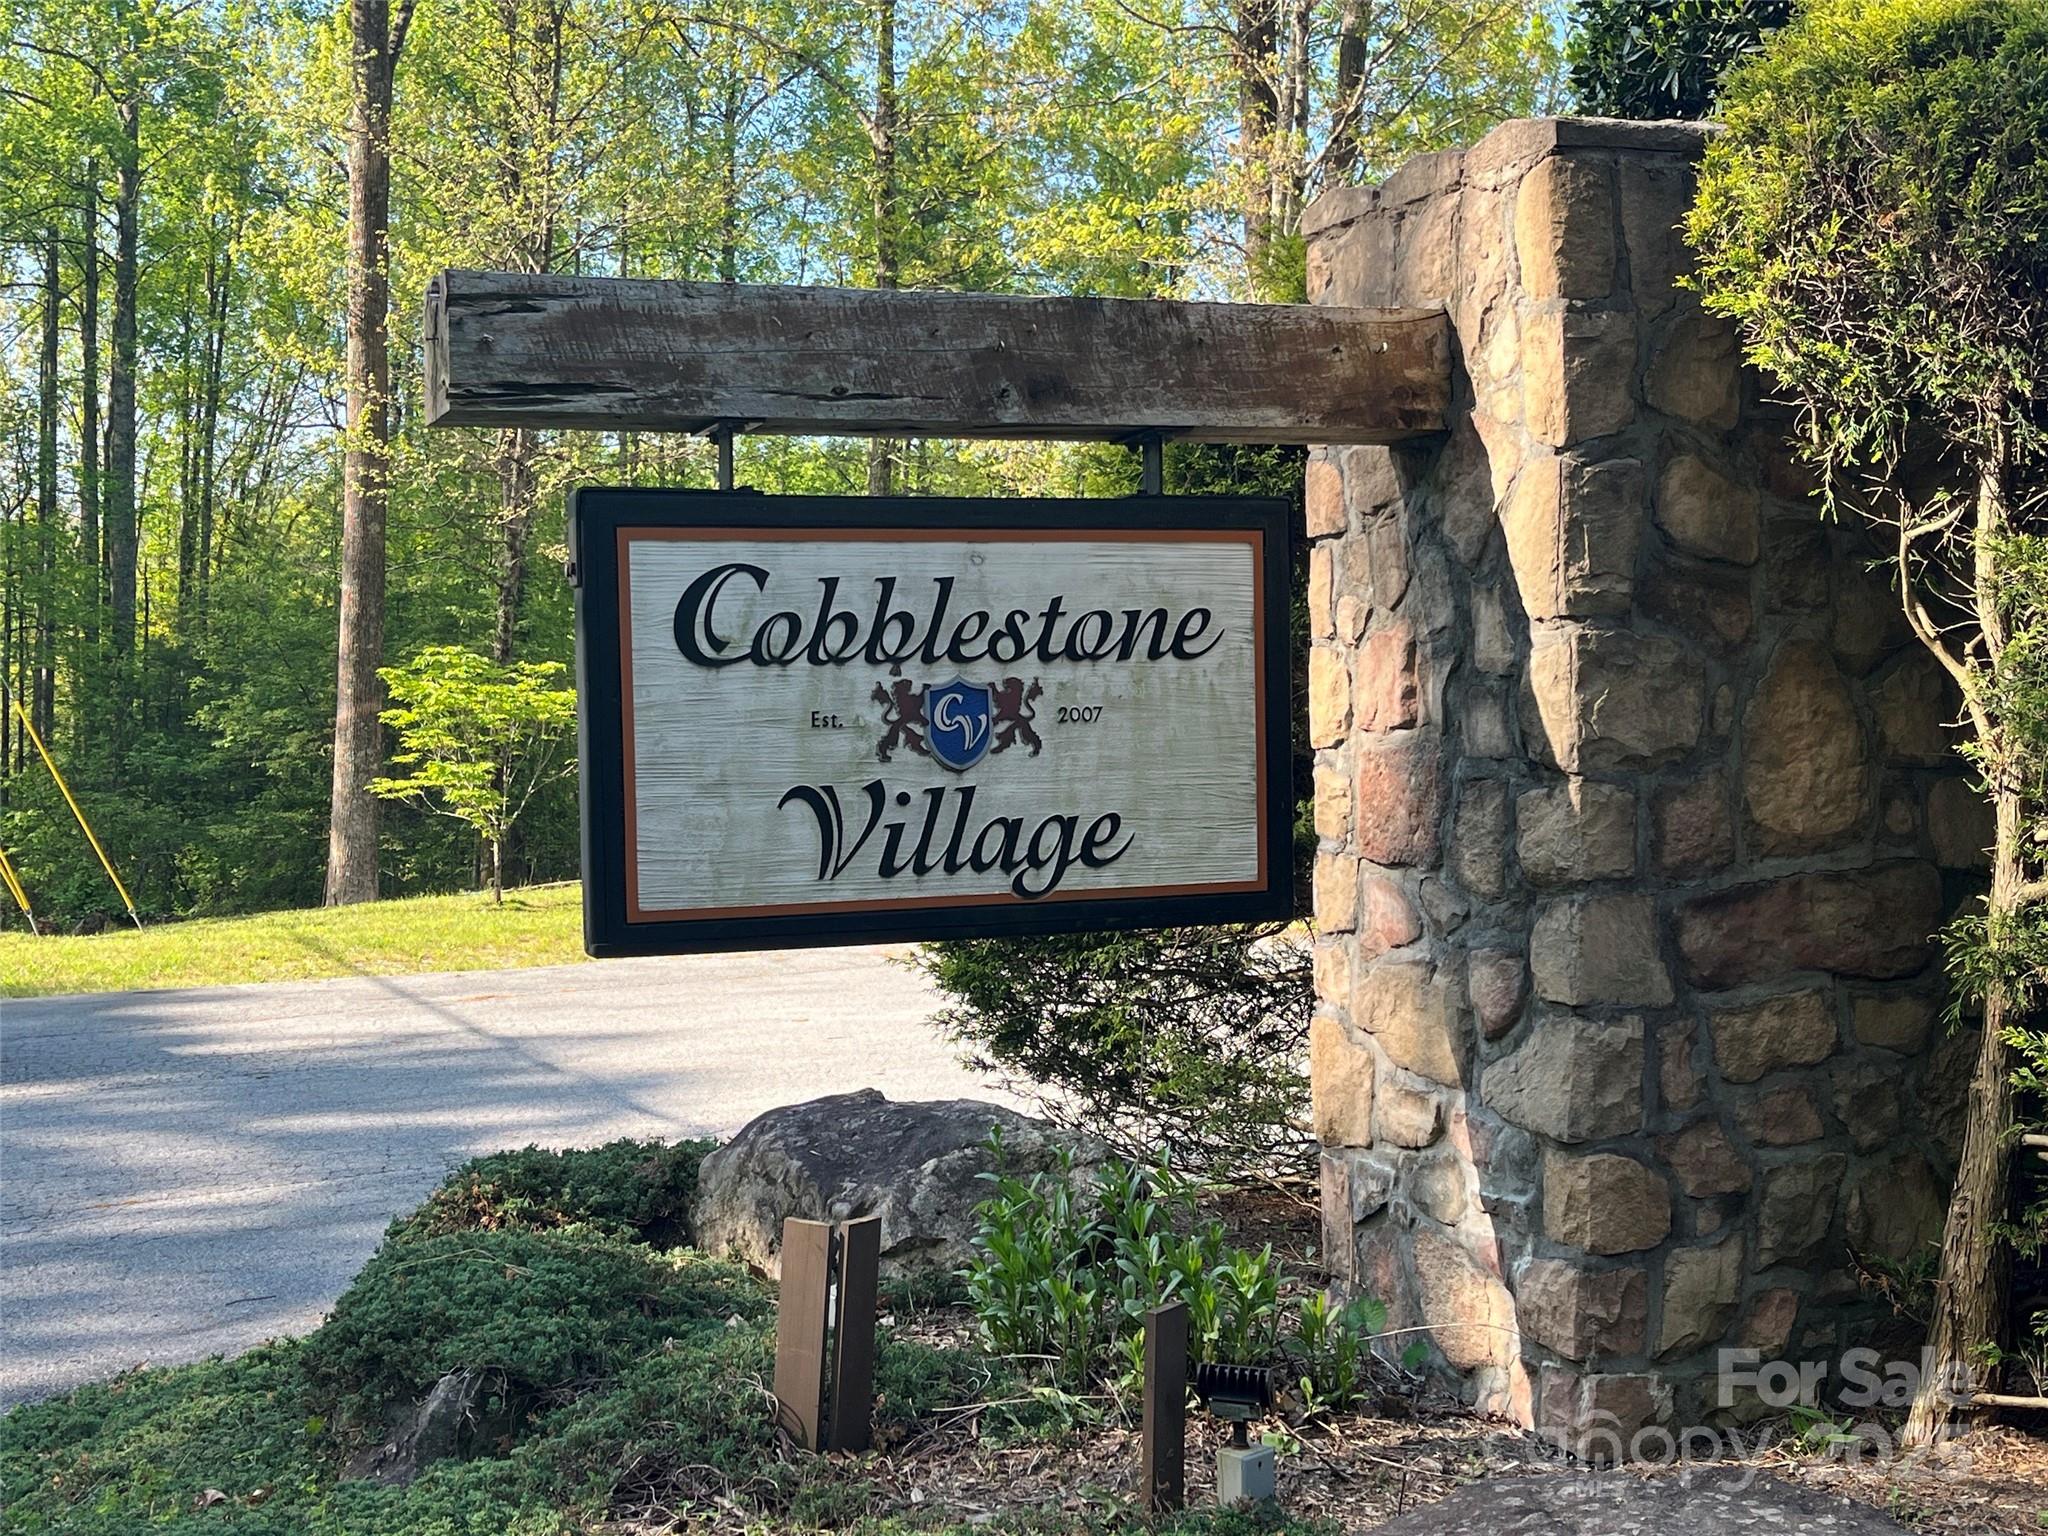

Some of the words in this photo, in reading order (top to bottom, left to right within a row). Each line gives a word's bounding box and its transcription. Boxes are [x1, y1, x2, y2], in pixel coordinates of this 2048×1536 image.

[673, 563, 1224, 667] Cobblestone
[811, 711, 844, 729] Est.
[1057, 706, 1104, 724] 2007
[778, 779, 1135, 899] Village
